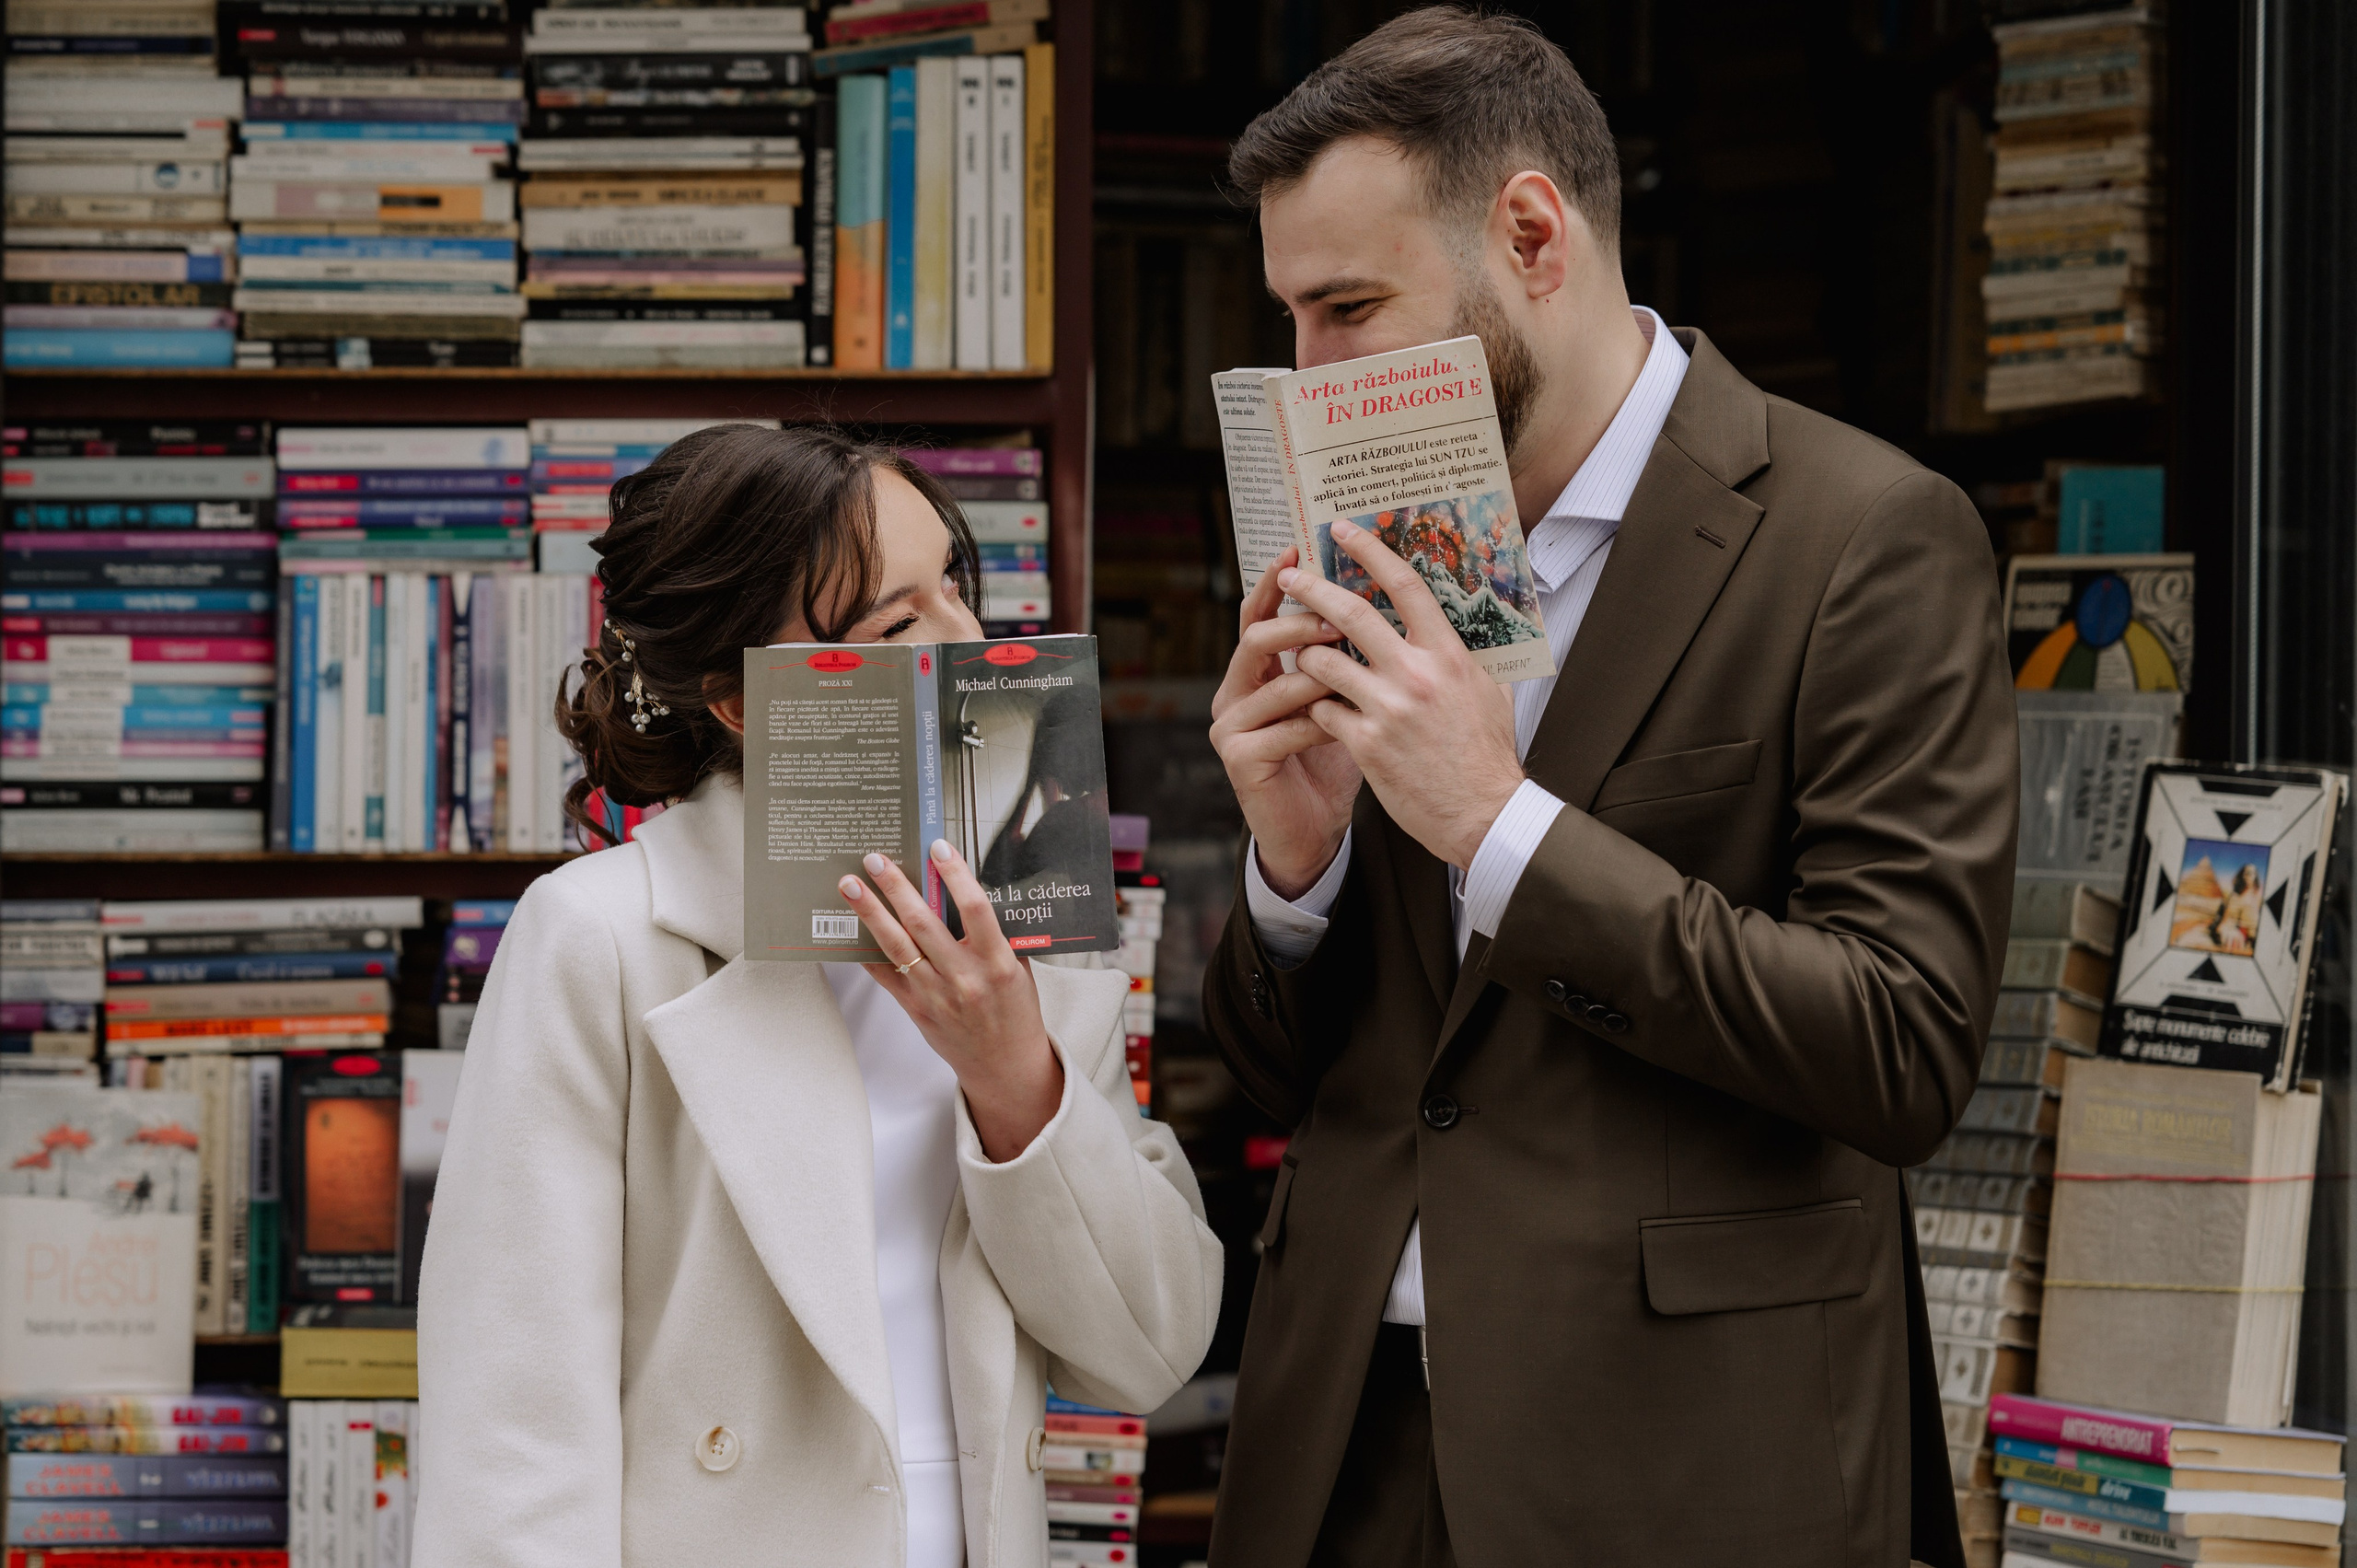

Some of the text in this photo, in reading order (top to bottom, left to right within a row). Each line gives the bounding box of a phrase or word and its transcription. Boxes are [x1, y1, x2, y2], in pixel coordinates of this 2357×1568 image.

[1294, 381, 1346, 405] Arta
[1326, 377, 1482, 425] ÎN DRAGOSTE
[1231, 407, 1243, 415] ultima
[1275, 400, 1292, 459] DRAGOSTE
[1329, 453, 1357, 468] ARTA
[1361, 439, 1427, 461] RĂZBOIULUI
[1429, 438, 1448, 448] este
[1288, 463, 1296, 475] ÎN
[1322, 469, 1368, 485] victoriei.
[1370, 460, 1414, 475] Strategia
[1415, 457, 1428, 467] lui
[1430, 451, 1452, 464] SUN
[1455, 447, 1476, 459] TZU
[1313, 487, 1345, 503] aplică
[1348, 485, 1357, 495] în
[1401, 470, 1436, 487] politică
[1369, 493, 1380, 504] să
[1433, 481, 1443, 492] în
[956, 674, 1073, 692] Michael Cunningham
[822, 727, 856, 735] Cunningham
[769, 759, 792, 768] punctele
[856, 758, 889, 767] Cunningham
[845, 773, 862, 781] cinice,
[875, 784, 901, 792] Magazine
[927, 787, 935, 796] la
[927, 799, 936, 825] Până
[768, 826, 785, 835] Henry
[786, 826, 802, 834] James
[831, 826, 848, 834] Mann,
[768, 833, 792, 842] picturale
[813, 833, 830, 841] Agnes
[863, 840, 884, 848] poveste
[1008, 885, 1022, 902] la
[1028, 881, 1091, 900] căderea
[2156, 1016, 2226, 1042] monumente
[2228, 1021, 2270, 1049] celebre
[39, 1463, 113, 1478] JAMES
[25, 1482, 125, 1496] CLAVELL
[37, 1510, 111, 1524] JAMES
[23, 1527, 122, 1542] CLAVELL
